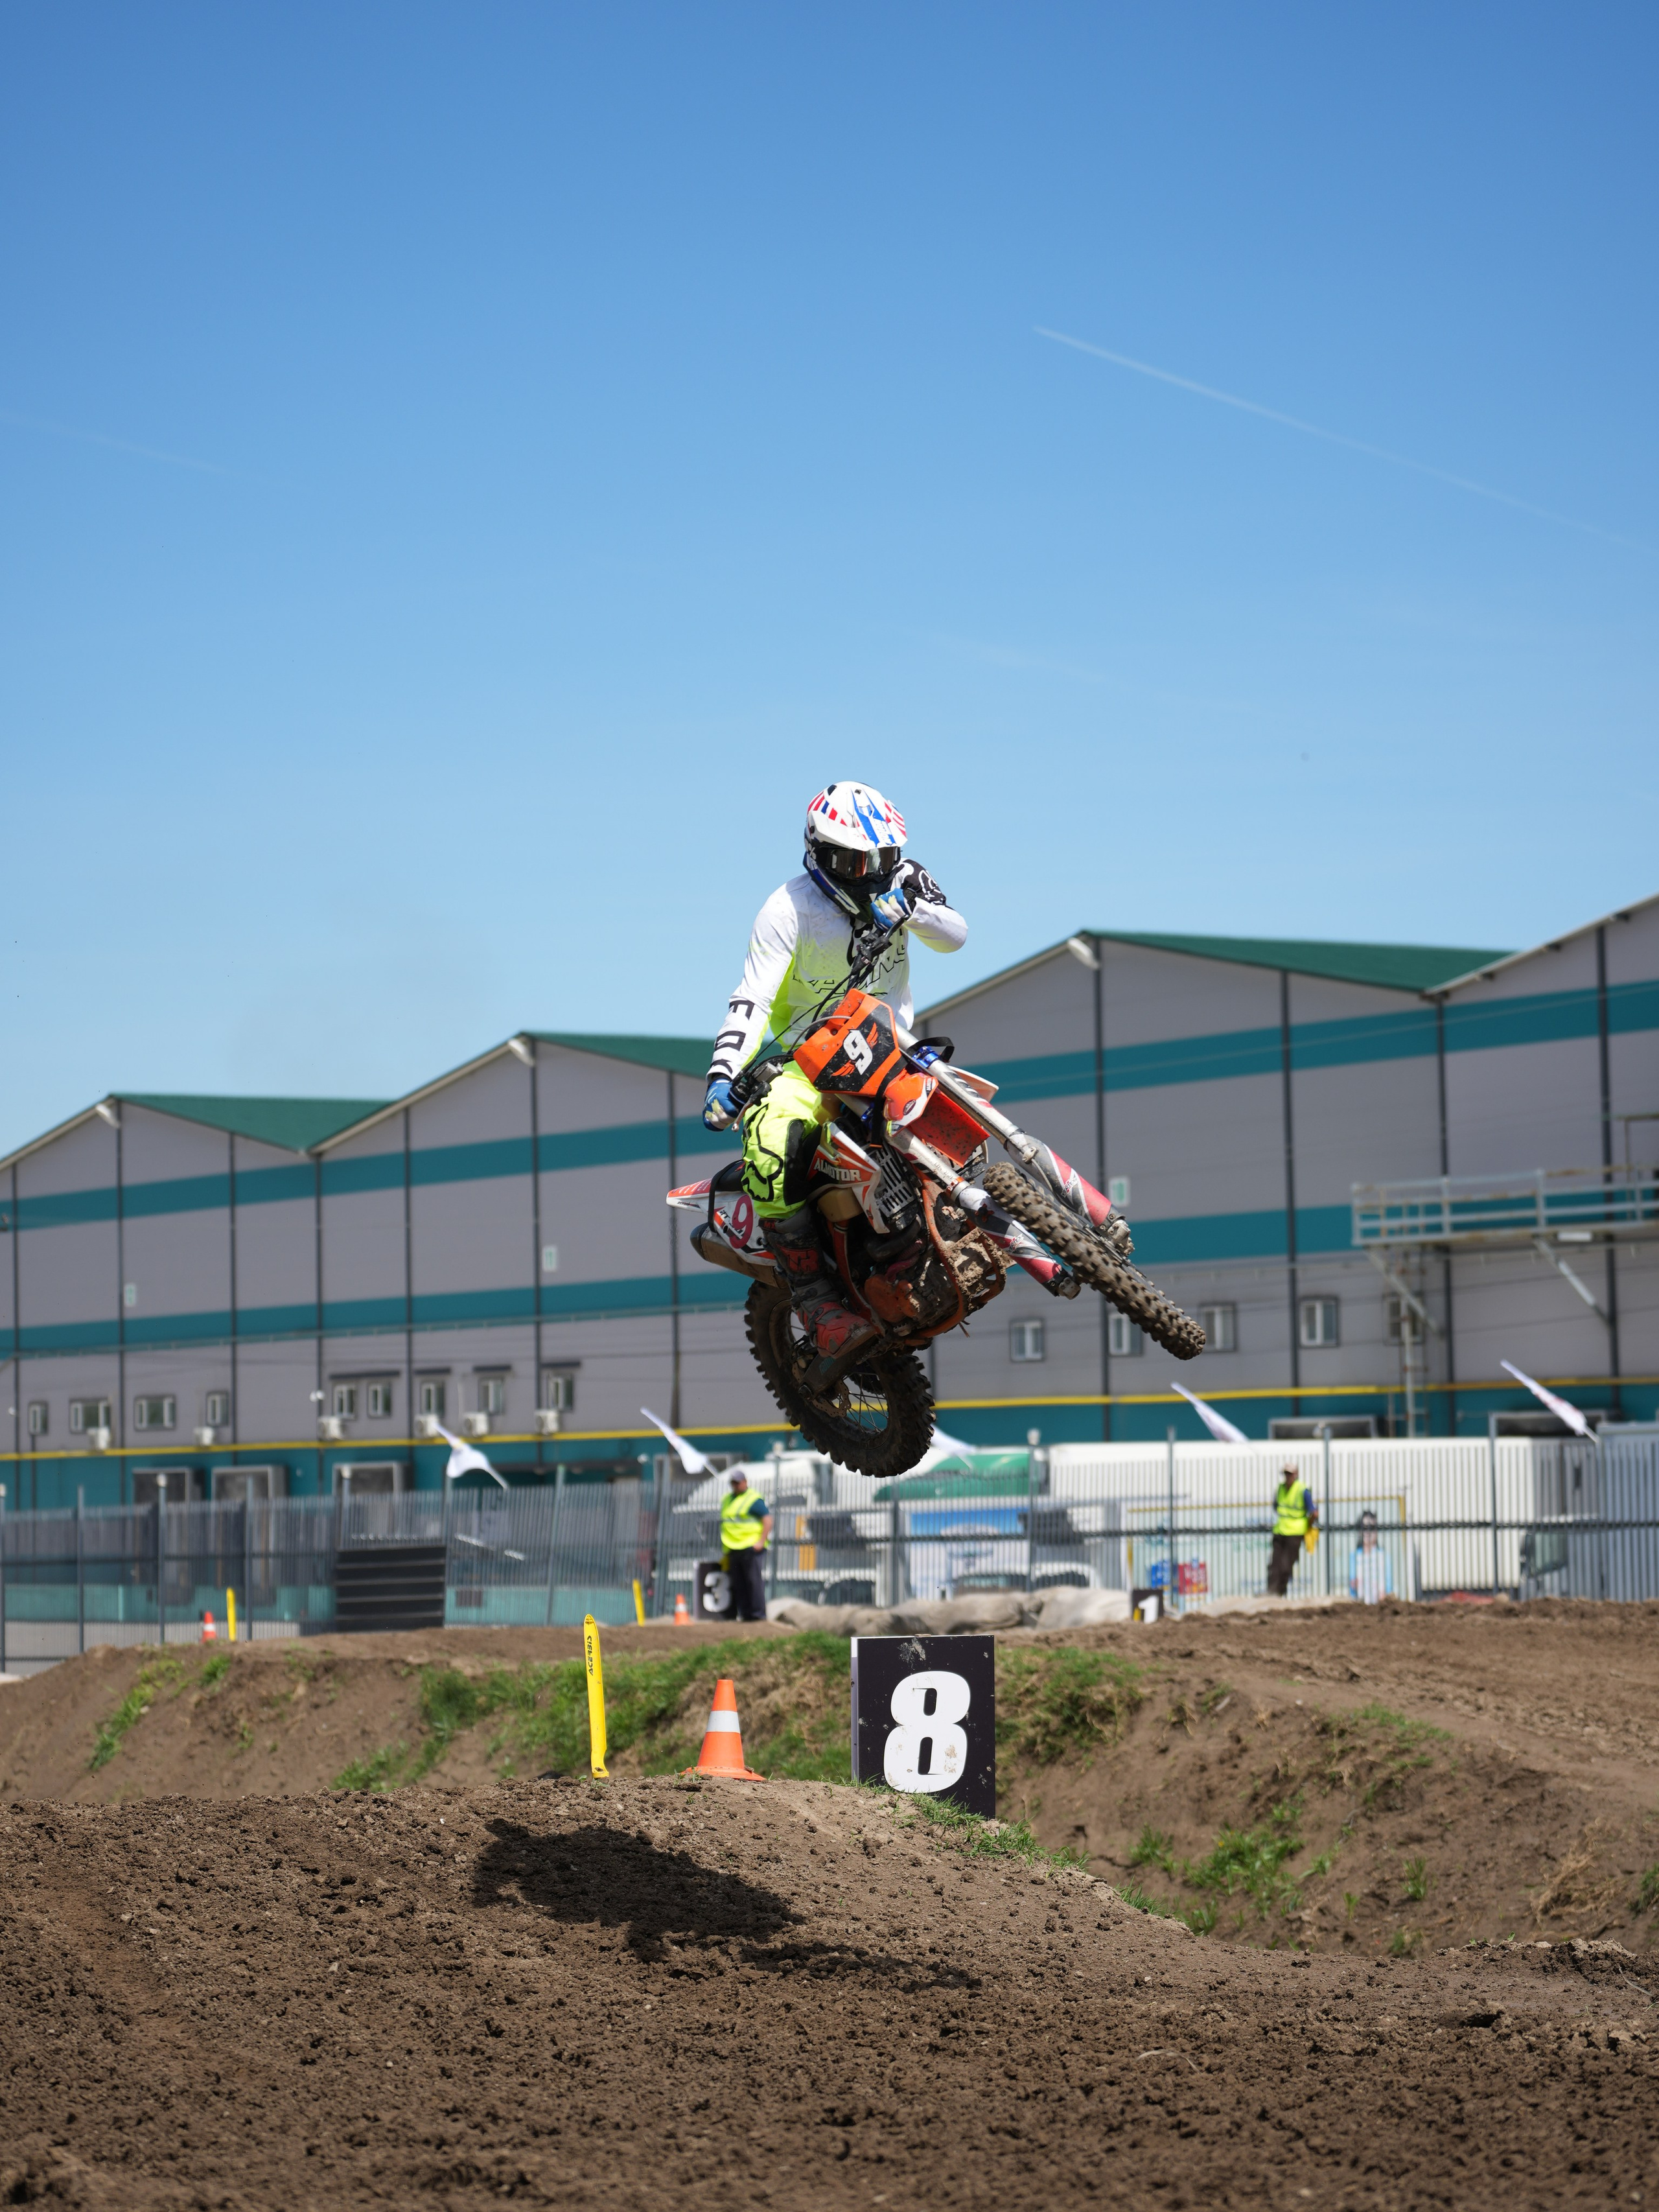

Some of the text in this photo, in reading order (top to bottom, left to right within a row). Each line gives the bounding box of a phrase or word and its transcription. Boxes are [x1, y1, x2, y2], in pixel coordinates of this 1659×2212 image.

[842, 1029, 874, 1076] 9
[813, 1158, 862, 1182] ALMOTOR
[729, 1194, 754, 1249] 9
[702, 1571, 730, 1612] 3
[1138, 1595, 1159, 1624] 1
[883, 1670, 971, 1793] 8
